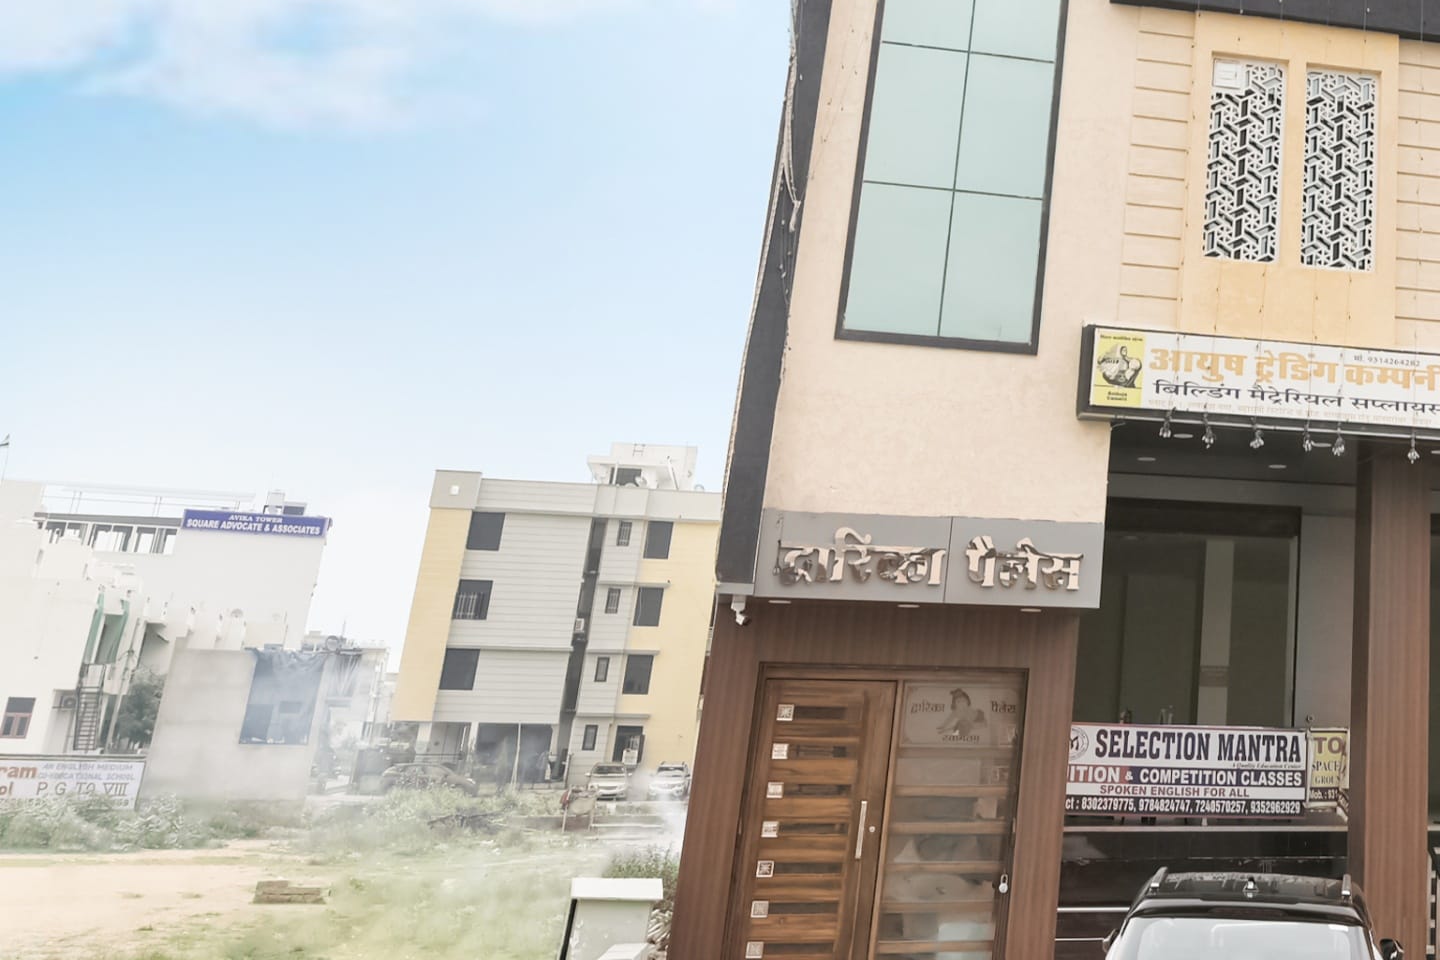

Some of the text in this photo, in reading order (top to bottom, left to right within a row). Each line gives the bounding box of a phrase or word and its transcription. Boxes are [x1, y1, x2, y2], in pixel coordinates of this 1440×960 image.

[1150, 349, 1248, 382] आयुष
[1254, 350, 1339, 384] ट्रेडिंग
[1153, 379, 1240, 400] बिल्डिंग
[187, 518, 321, 535] SQUARE ADVOCATE & ASSOCIATES
[777, 527, 1084, 591] द्वारिका पैलेस
[1095, 729, 1301, 762] SELECTION MANTRA
[1067, 765, 1302, 786] ITION & COMPETITION CLASSES
[1100, 785, 1250, 798] SPOKEN ENGLISH FOR ALL
